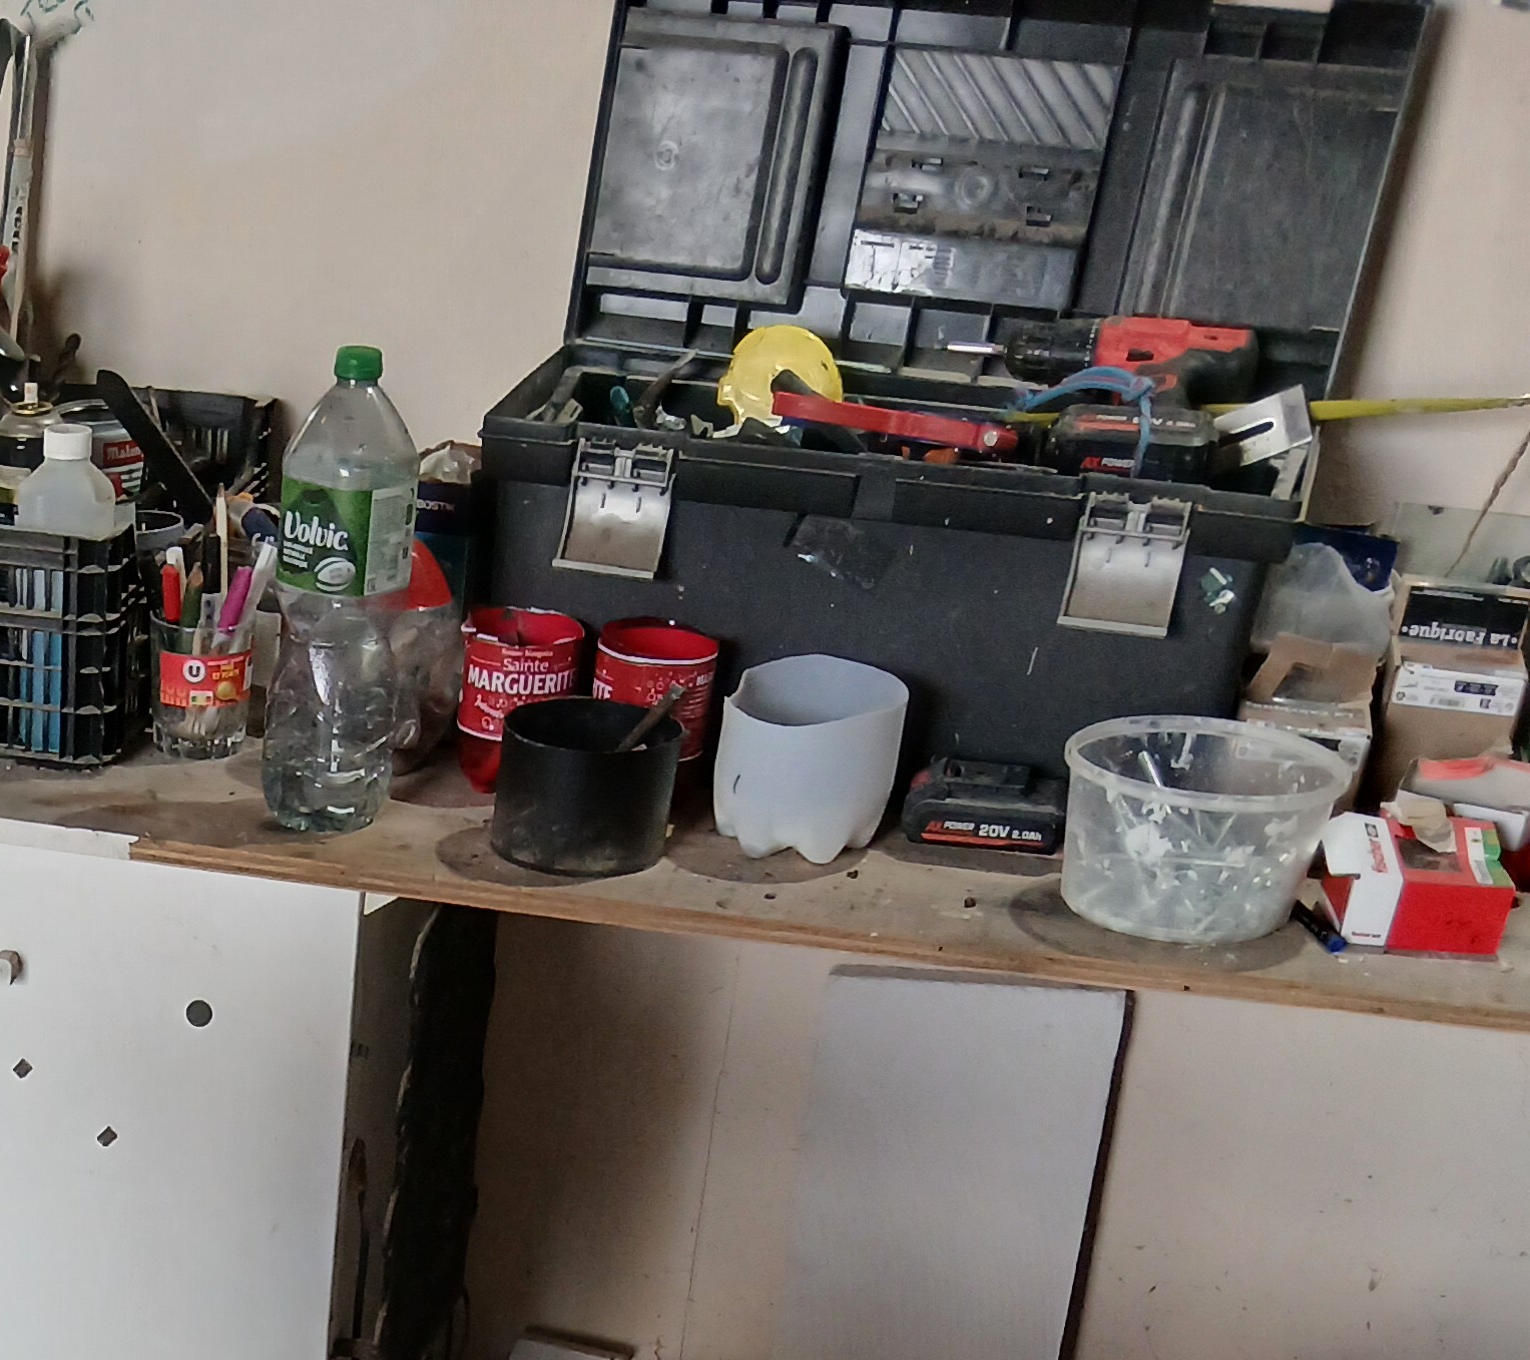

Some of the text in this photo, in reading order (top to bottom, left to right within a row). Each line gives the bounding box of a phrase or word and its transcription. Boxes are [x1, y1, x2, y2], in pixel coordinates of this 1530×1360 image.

[284, 509, 349, 551] Volvic
[503, 658, 549, 673] Sainte
[978, 823, 1011, 838] 20V
